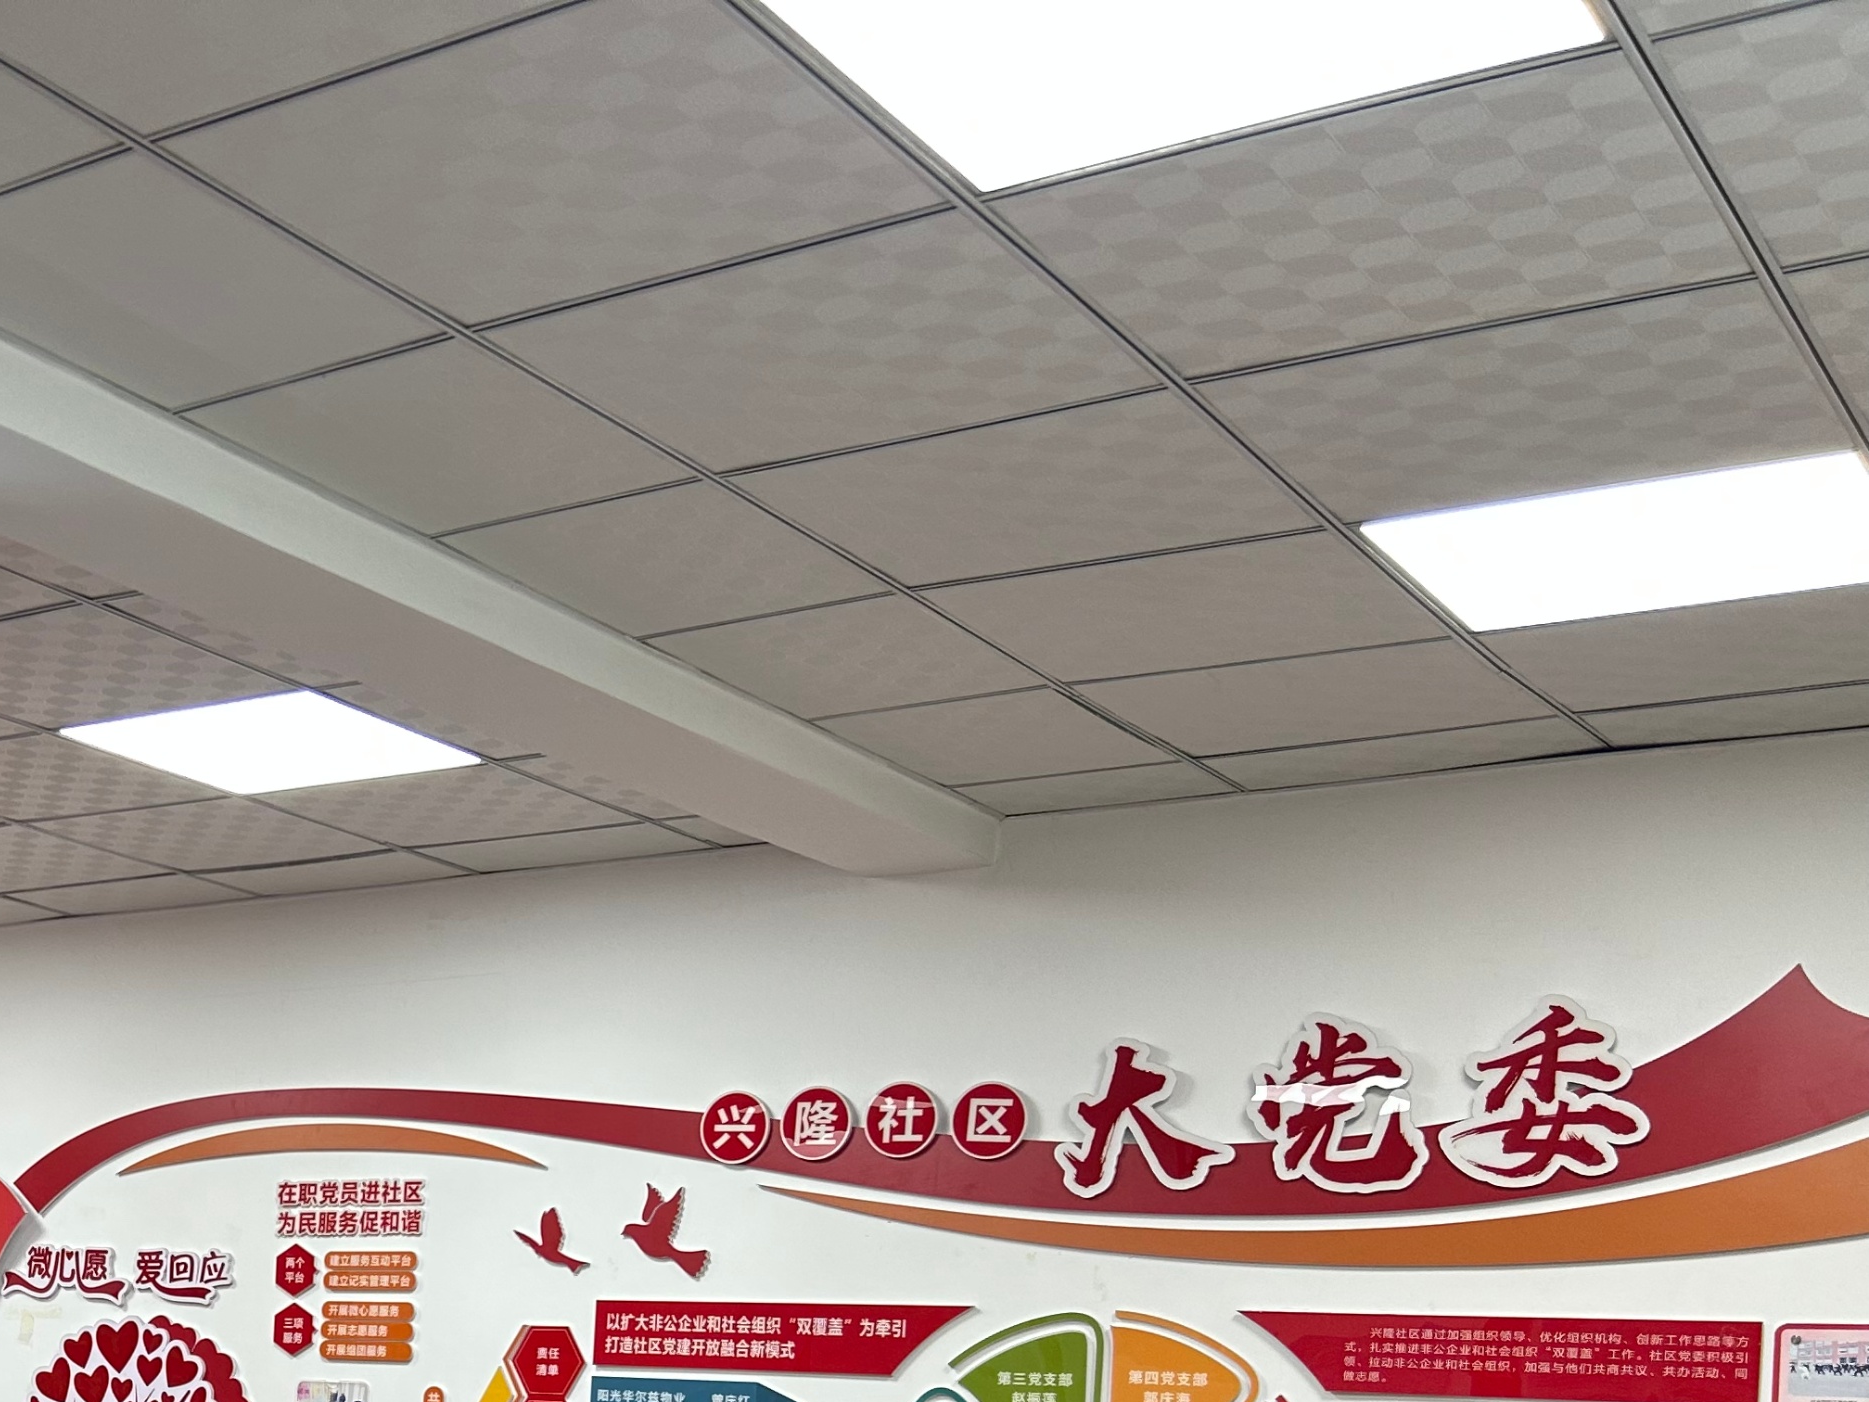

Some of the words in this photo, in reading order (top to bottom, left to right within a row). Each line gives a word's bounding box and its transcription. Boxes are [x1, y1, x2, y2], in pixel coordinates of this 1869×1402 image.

[708, 1092, 1016, 1154] 兴隆社区
[1064, 1003, 1643, 1191] 大党委
[278, 1180, 423, 1205] 在职党员进社区
[278, 1209, 422, 1234] 为民服务促和谐
[285, 1257, 305, 1269] 两个
[330, 1254, 411, 1267] 建立服务互动平台
[20, 1246, 114, 1290] 微心愿
[135, 1249, 231, 1288] 爱回应
[285, 1272, 305, 1284] 平台
[329, 1275, 410, 1288] 建立记实管理平台
[328, 1305, 399, 1317] 开展微心愿服务
[283, 1317, 304, 1329] 三项
[327, 1324, 388, 1337] 开展志愿服务
[283, 1332, 303, 1344] 服务
[536, 1347, 560, 1360] 责任
[605, 1336, 796, 1360] 打造社区党建开放融合新模式
[535, 1363, 560, 1377] 清单
[997, 1370, 1073, 1388] 第三党支部
[1128, 1369, 1209, 1388] 第四党支部
